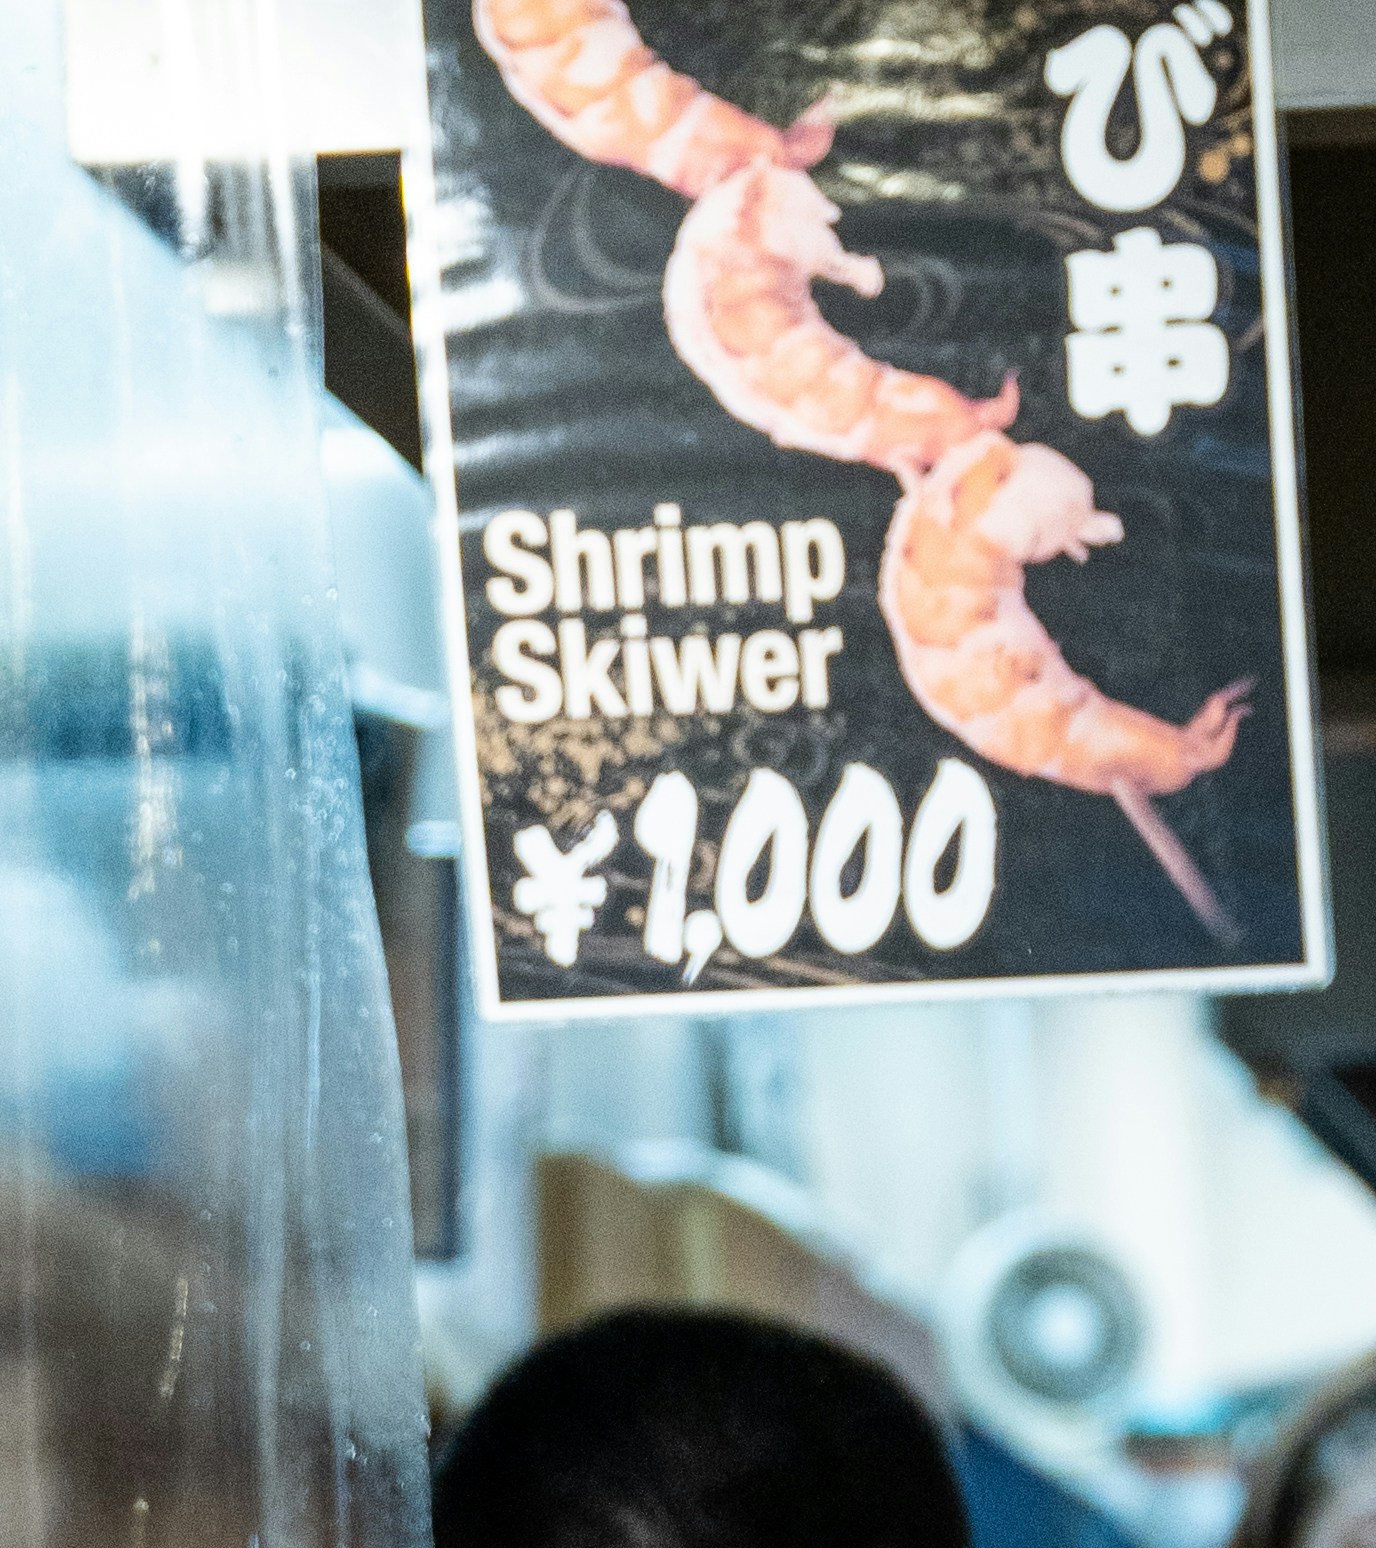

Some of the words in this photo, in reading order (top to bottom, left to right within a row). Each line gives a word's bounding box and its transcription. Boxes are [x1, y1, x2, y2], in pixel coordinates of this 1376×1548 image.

[1044, 0, 1234, 437] び串
[483, 503, 846, 621] Shrimp
[493, 615, 844, 724] Skiwer
[511, 757, 998, 988] ¥1,000
